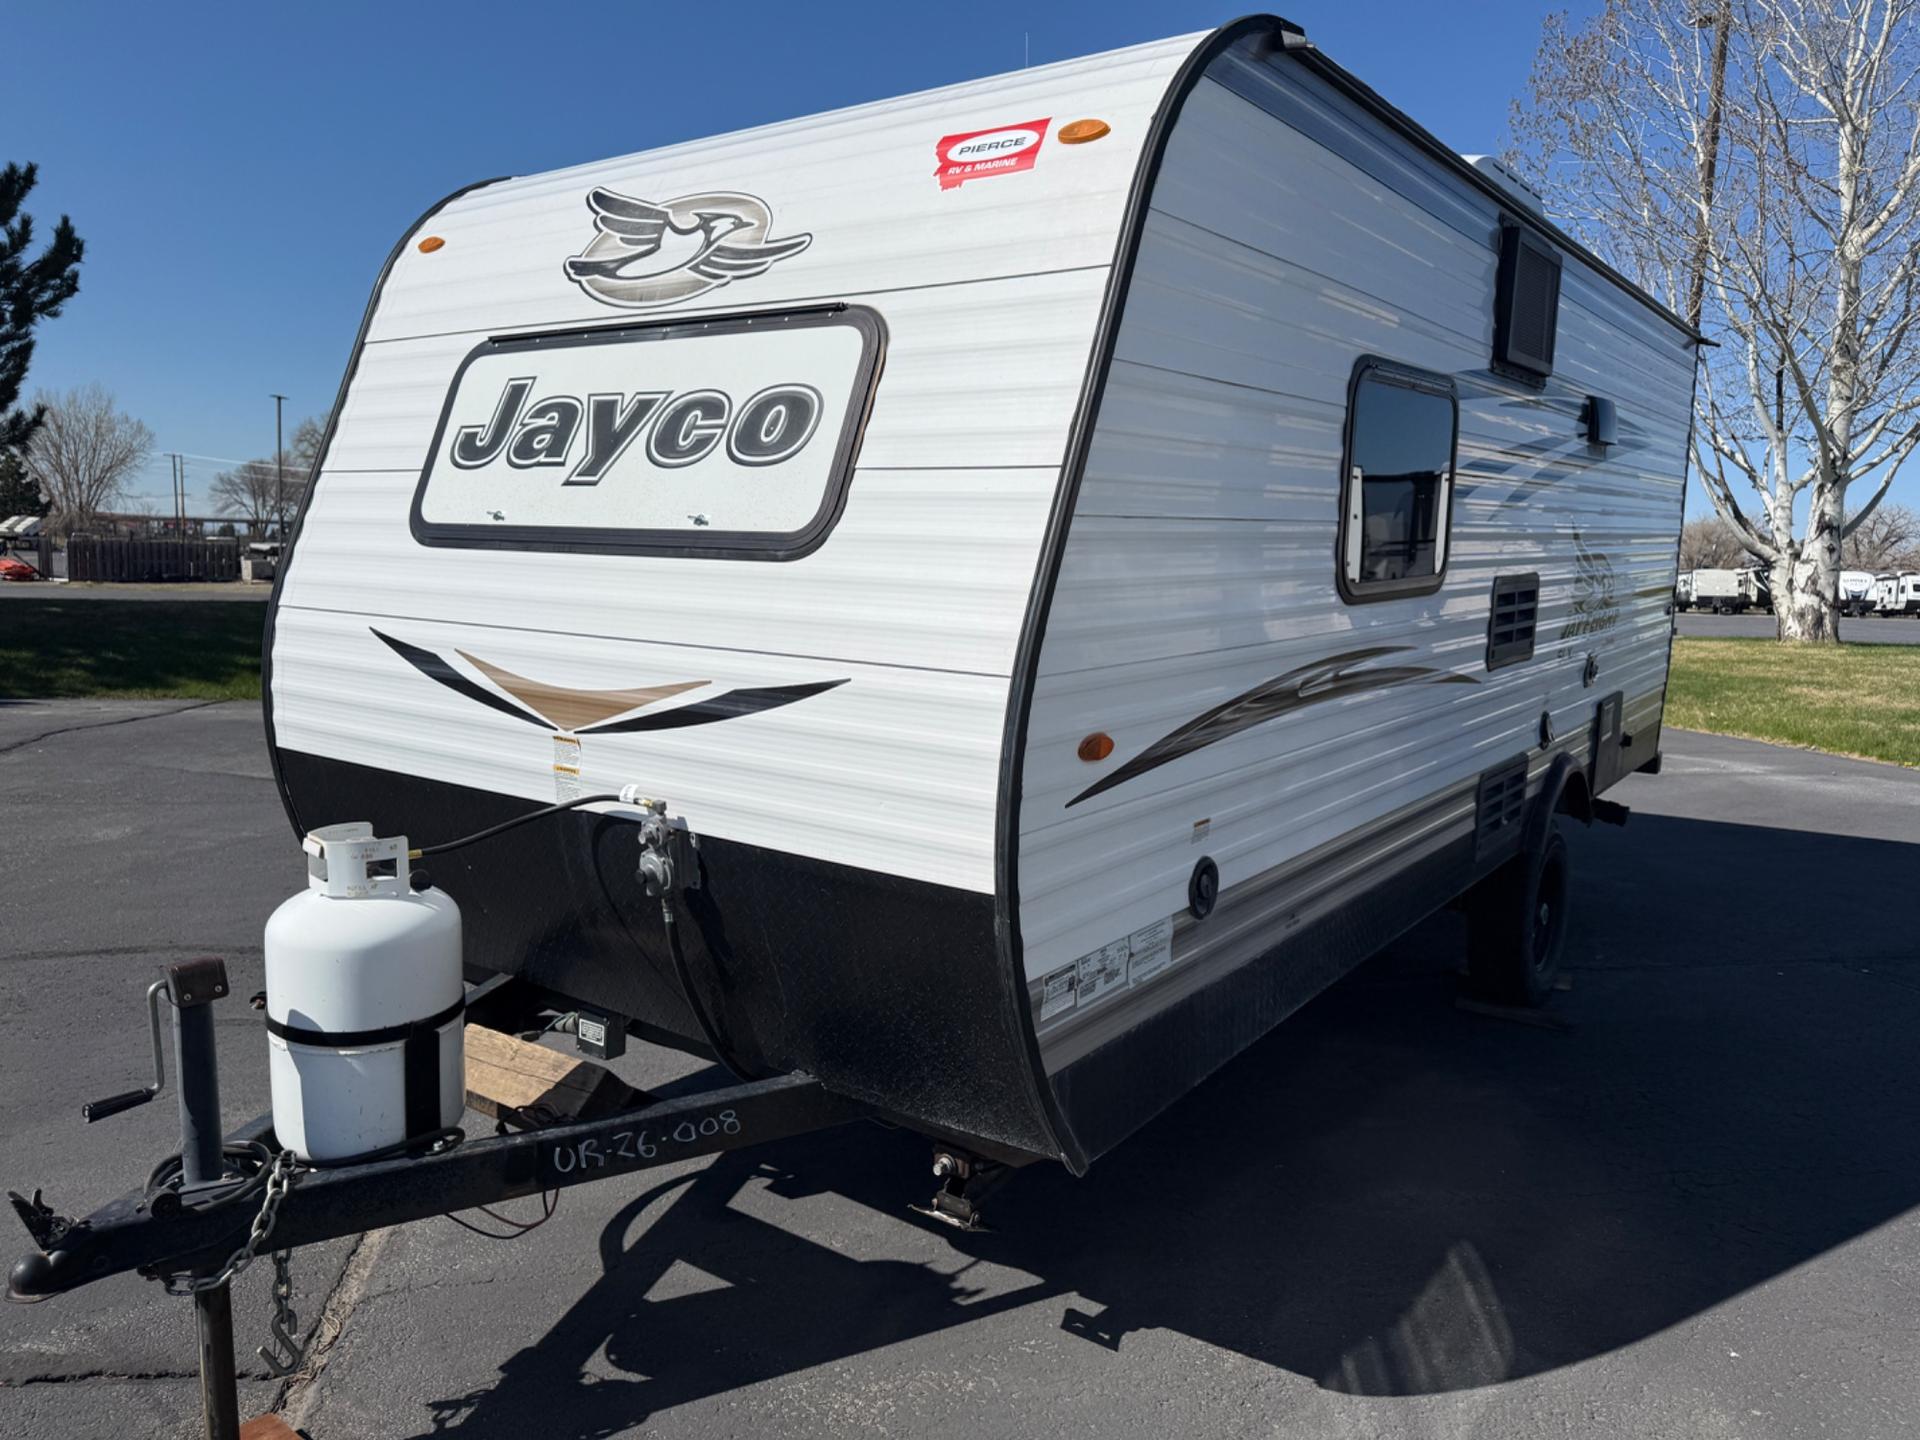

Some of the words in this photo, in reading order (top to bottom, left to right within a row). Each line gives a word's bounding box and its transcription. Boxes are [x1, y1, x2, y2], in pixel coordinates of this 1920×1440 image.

[958, 136, 1027, 156] PIERCE
[947, 165, 962, 176] RV
[964, 164, 973, 173] &
[974, 157, 1018, 171] MARINE
[450, 375, 825, 487] Jayco
